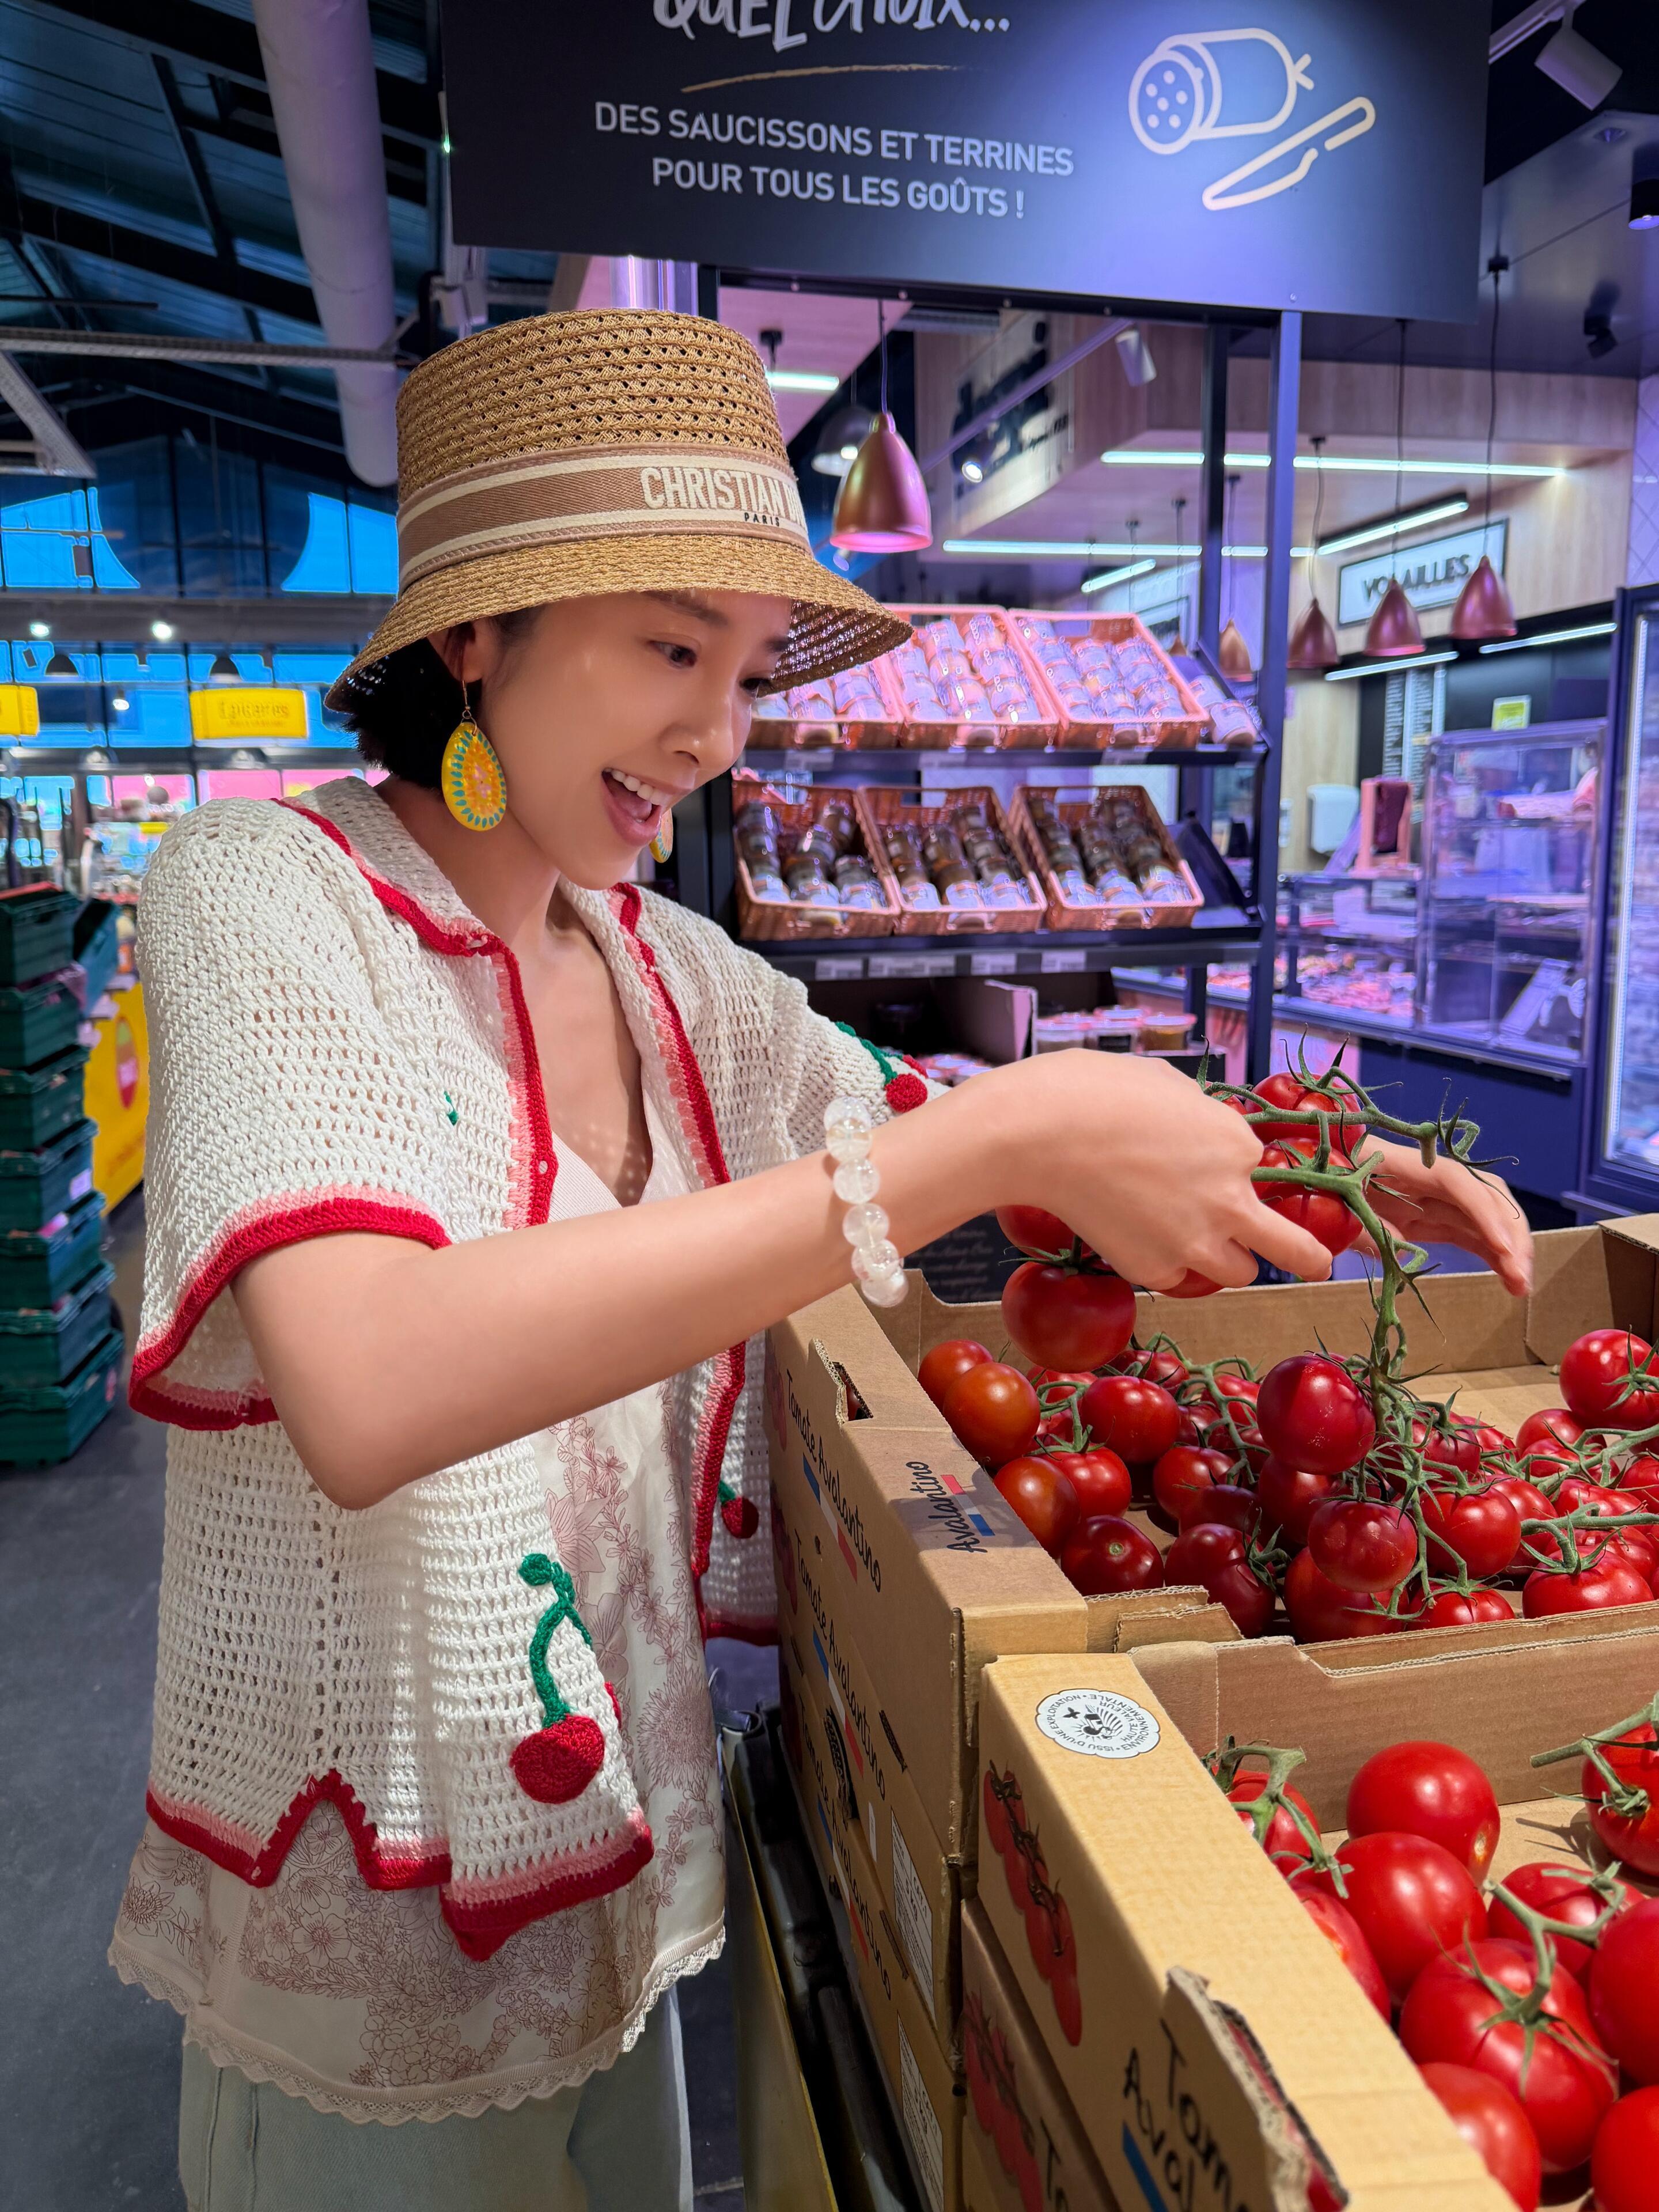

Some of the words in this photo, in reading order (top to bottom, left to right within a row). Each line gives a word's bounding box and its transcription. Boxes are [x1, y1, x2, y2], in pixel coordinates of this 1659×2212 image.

[595, 101, 660, 135] DES
[668, 109, 873, 157] SAUCISSONS
[880, 128, 919, 161] ET
[925, 134, 1074, 176] TERRINES
[652, 157, 743, 195] POUR
[749, 165, 834, 202] TOUS
[842, 175, 900, 207] LES
[907, 177, 1008, 218] GOÛTS
[1015, 190, 1024, 219] !
[641, 467, 786, 518] CHRISTIAN
[744, 512, 780, 527] PARIS
[786, 1369, 816, 1453] Tomate
[816, 1443, 881, 1593] Avalantino
[906, 1461, 988, 1554] Avalantino
[794, 1528, 827, 1641] Tomate
[829, 1619, 885, 1801] Avalantino
[1046, 1694, 1082, 1729] EXPLOITATION
[1089, 1694, 1150, 1751] ENVIRONNEMENTALE
[1099, 1700, 1134, 1722] VALEUR
[1122, 1722, 1139, 1743] HAUTE
[1054, 1730, 1085, 1748] D'UNE
[1088, 1743, 1115, 1752] ISSU
[1160, 2018, 1250, 2212] Tom
